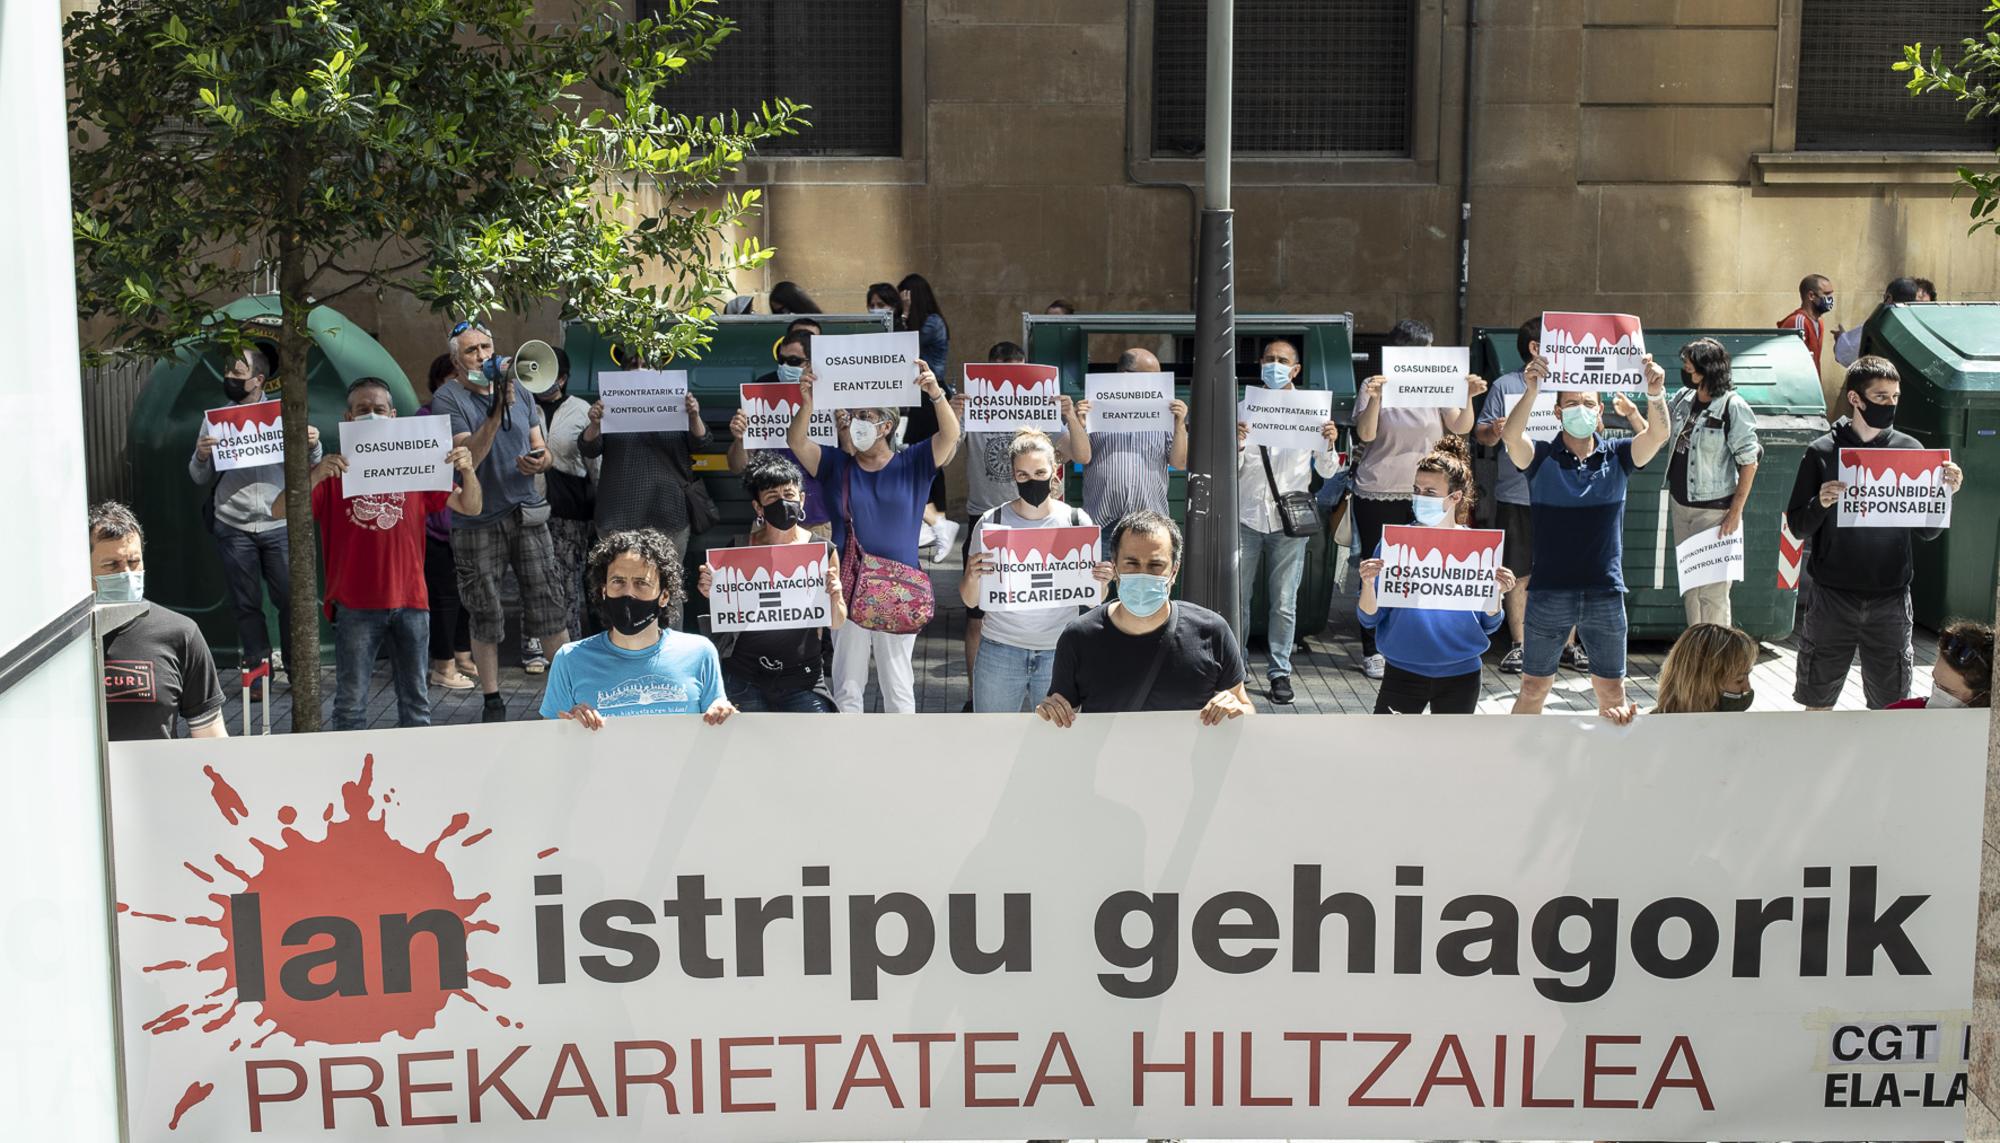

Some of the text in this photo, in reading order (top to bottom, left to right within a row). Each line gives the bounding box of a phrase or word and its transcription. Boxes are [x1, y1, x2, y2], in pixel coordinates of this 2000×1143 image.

[1545, 344, 1644, 356] SUBCONTRATACIÓN
[825, 354, 906, 366] OSASUNBIDEA
[1393, 364, 1458, 373] OSASUNBIDEA
[1543, 372, 1643, 385] PRECARIEDAD
[833, 380, 903, 391] ERANTZULE!
[1399, 386, 1454, 394] ERANTZULE!
[602, 388, 673, 397] AZPIKONTRATARIK
[1096, 391, 1163, 400] OSASUNBIDEA
[969, 395, 1056, 409] ¡OSASUNBIDEA
[611, 405, 678, 414] KONTROLIK GABE
[969, 409, 1057, 421] RESPONSABLE!
[1102, 411, 1160, 419] ERANTZULE!
[1246, 404, 1318, 416] AZPIKONTRATARIK
[746, 413, 832, 425] ¡OSASUDEA
[1252, 422, 1297, 431] KONTROLIK
[216, 429, 284, 449] ¡OSASUNBID
[218, 442, 284, 460] RESPONSAB
[355, 438, 439, 454] OSASUNBIDEA
[363, 464, 435, 478] ERANTZULE!
[1843, 485, 1946, 499] ¡OSASUNBIDEA
[1843, 501, 1946, 514] RESPONSABLE!
[1684, 557, 1723, 575] KONTROLIK
[1385, 565, 1494, 581] ¡OSASUNBIDEA
[716, 576, 824, 593] SUBCONTRATACIÓN
[1384, 581, 1494, 598] RESPONSABLE!
[989, 587, 1095, 604] PRECARIEDAD
[717, 606, 825, 625] PRECARIEDAD
[104, 676, 144, 686] CURL
[230, 864, 1932, 1003] lan istripu gehiagorik
[1832, 1024, 1937, 1062] CGT
[245, 1031, 1716, 1133] PREKARIETATEA HILTZAILEA
